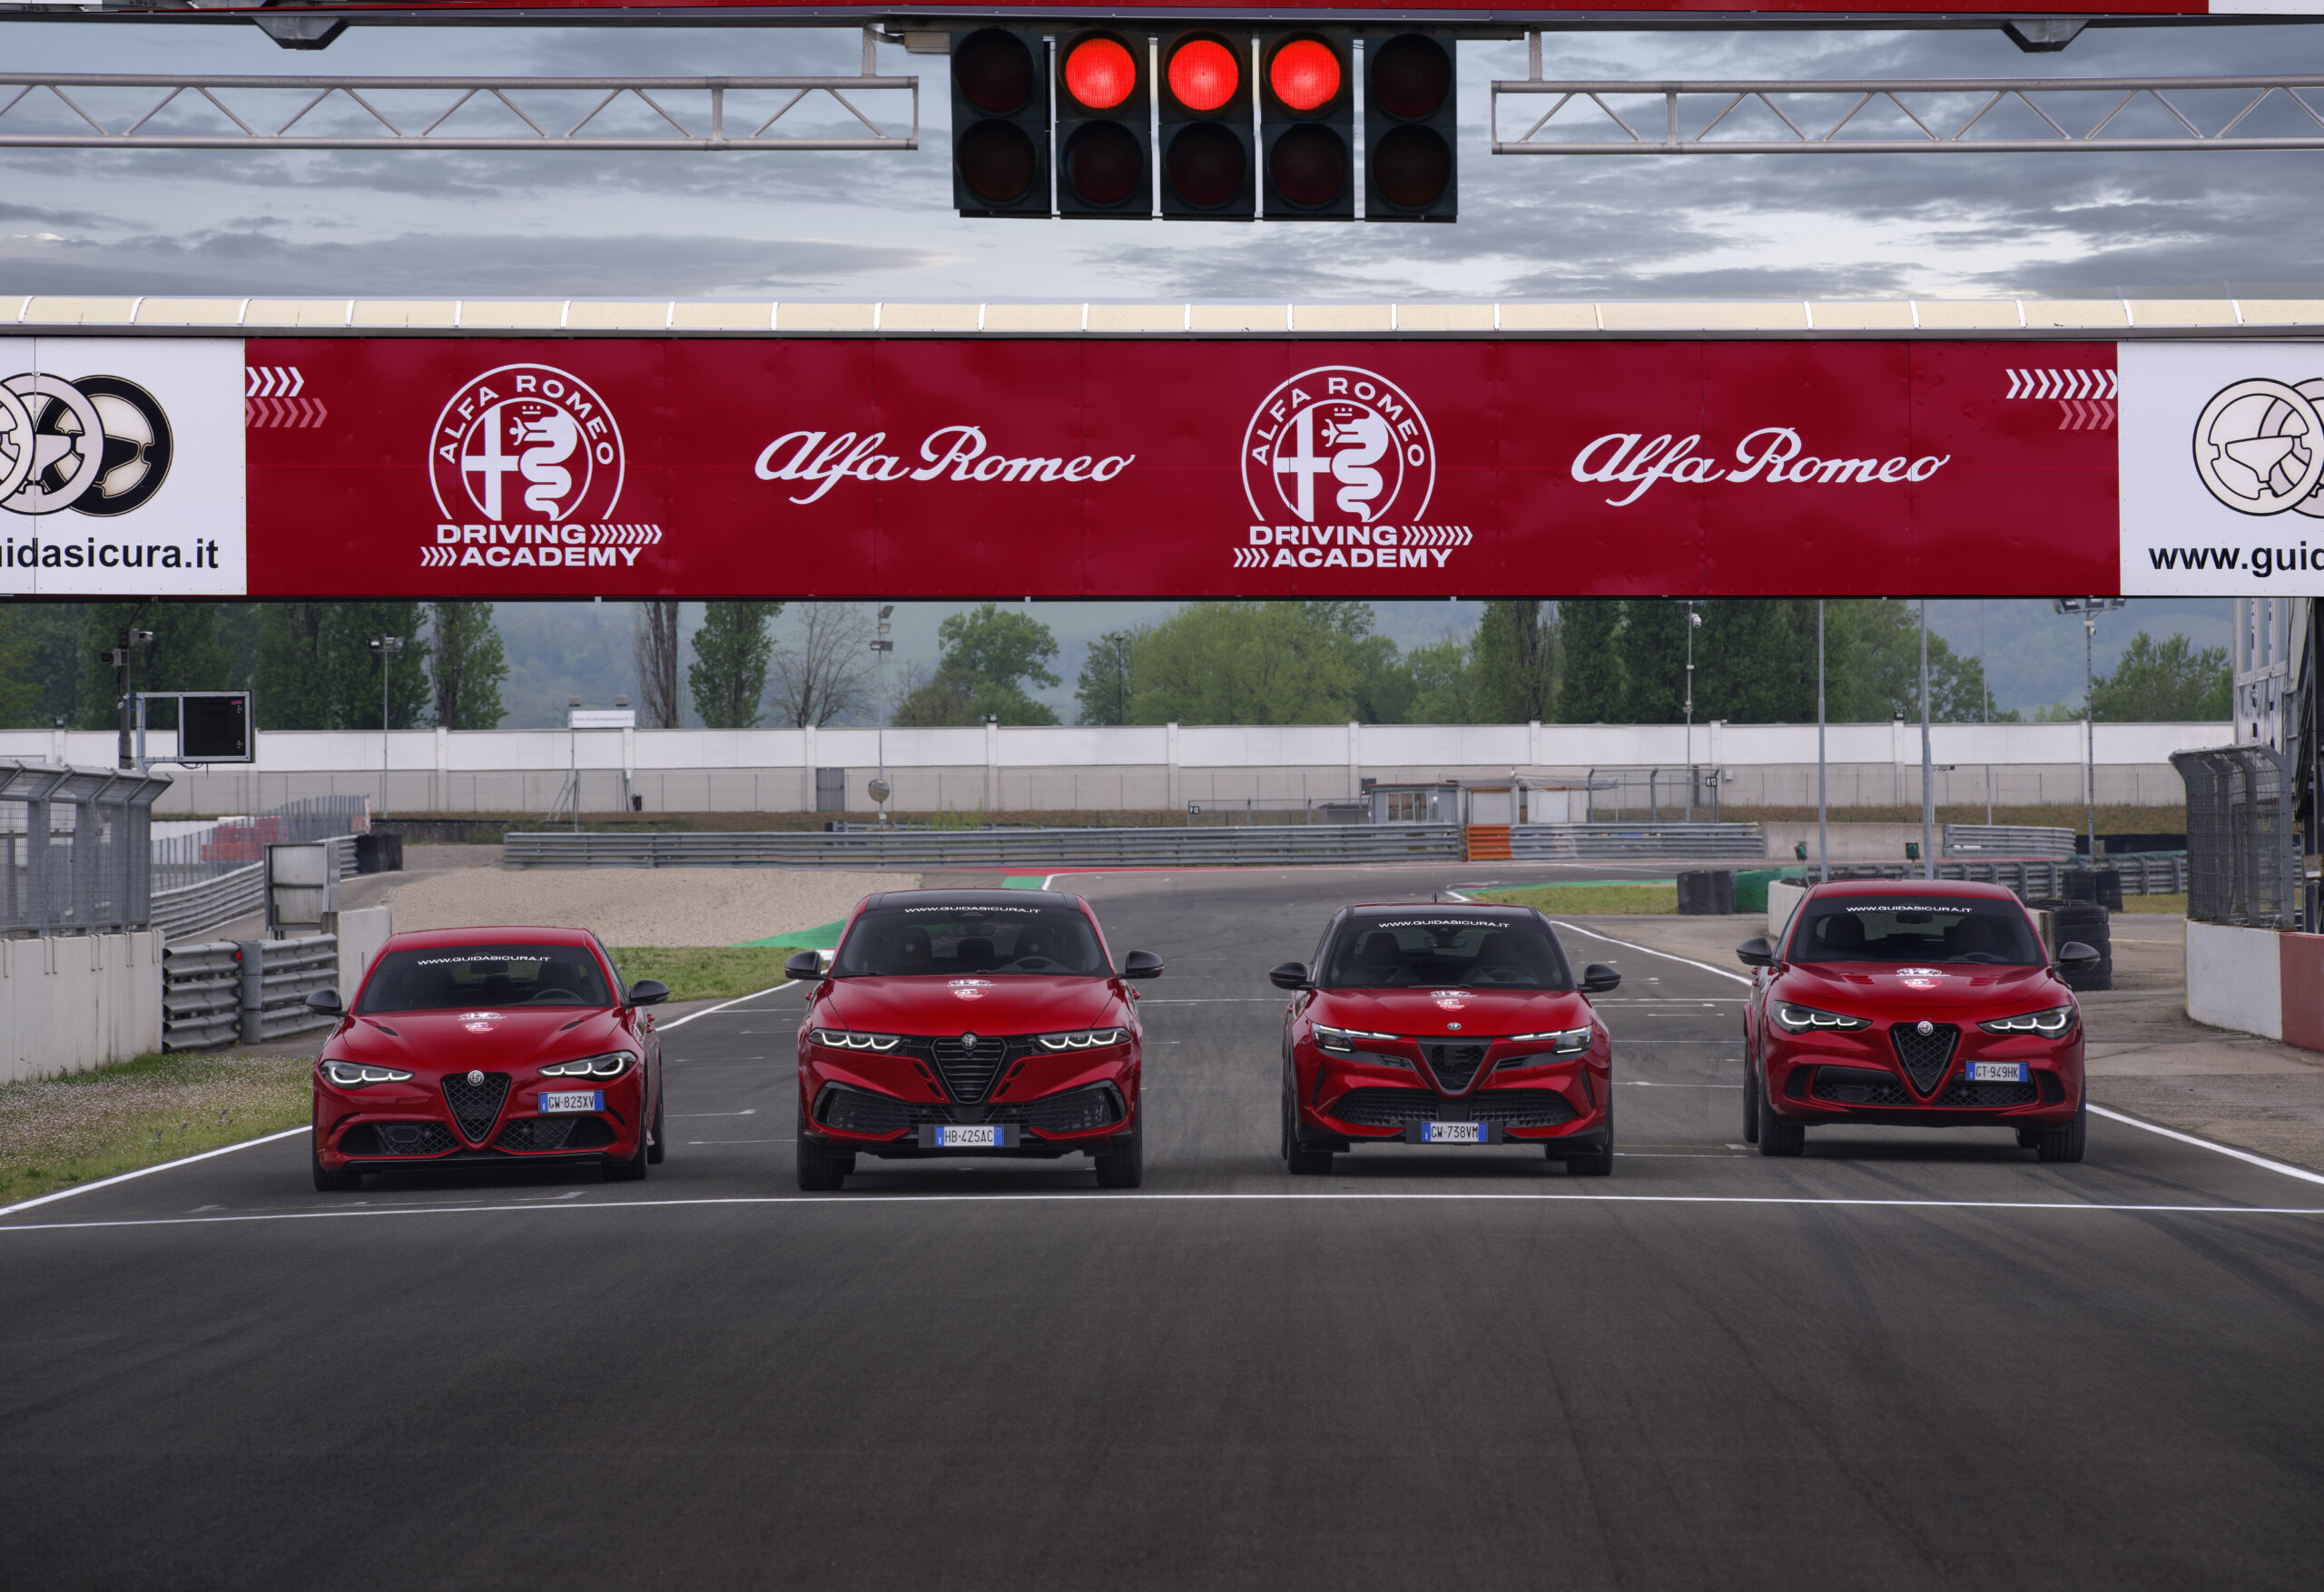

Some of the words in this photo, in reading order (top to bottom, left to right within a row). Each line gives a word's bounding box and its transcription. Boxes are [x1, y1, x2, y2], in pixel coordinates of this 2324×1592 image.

[438, 386, 499, 465] ALFA
[516, 375, 614, 465] ROMEO
[1252, 388, 1312, 467] ALFA
[1327, 377, 1425, 467] ROMEO
[754, 431, 910, 505] Alfa
[910, 426, 1135, 482] Romeo
[1571, 433, 1725, 506] Alfa
[1726, 427, 1951, 483] Romeo
[437, 524, 586, 545] DRIVING
[1249, 526, 1398, 545] DRIVING
[0, 537, 219, 569] idasicura.it
[459, 546, 643, 567] ACADEMY
[1272, 548, 1453, 568] ACADEMY
